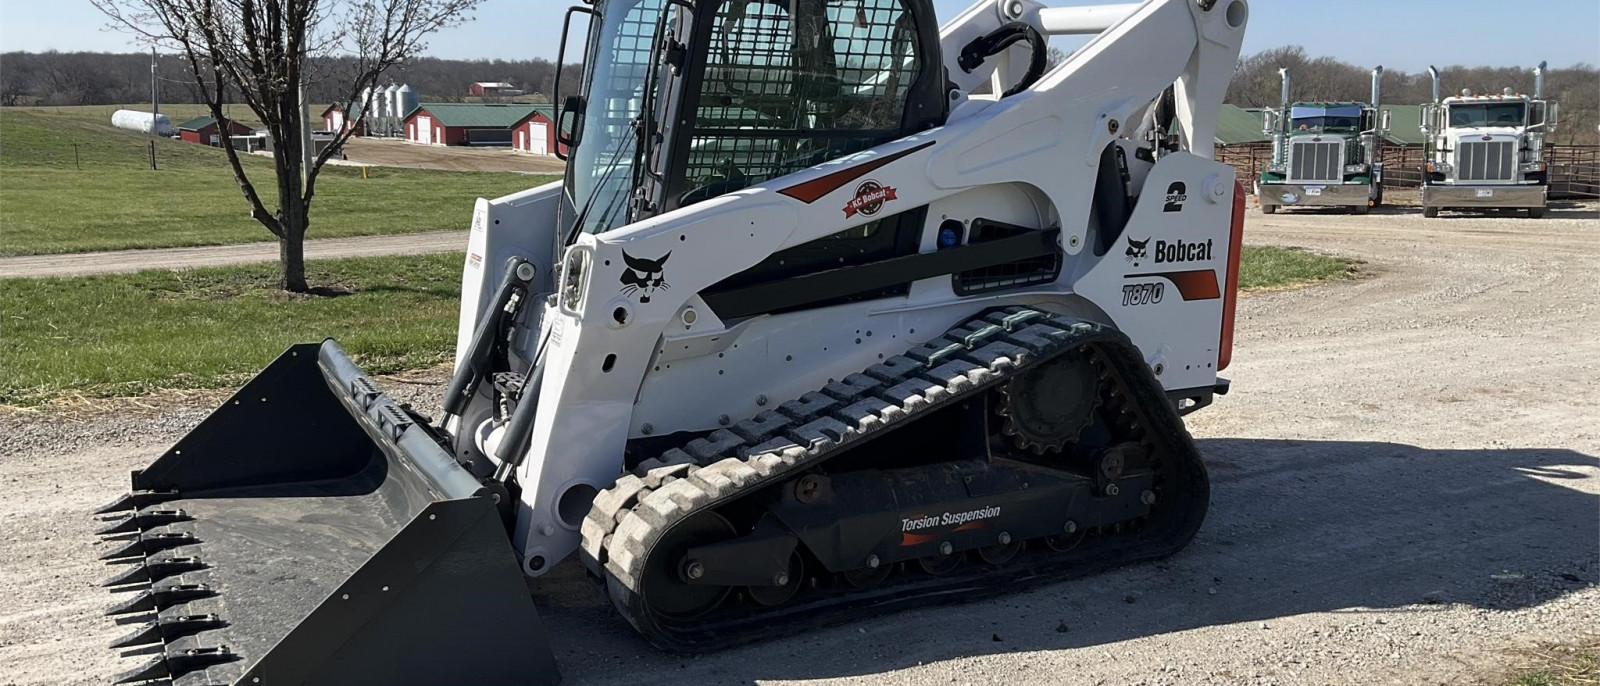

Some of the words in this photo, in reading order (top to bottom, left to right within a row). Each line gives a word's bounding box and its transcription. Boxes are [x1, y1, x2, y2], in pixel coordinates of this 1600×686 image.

[862, 189, 886, 203] Bobcat
[1163, 181, 1186, 212] 2
[1155, 239, 1213, 263] Bobcat
[1122, 282, 1165, 306] T870
[902, 516, 940, 531] Torsion
[941, 506, 1001, 525] Suspension
